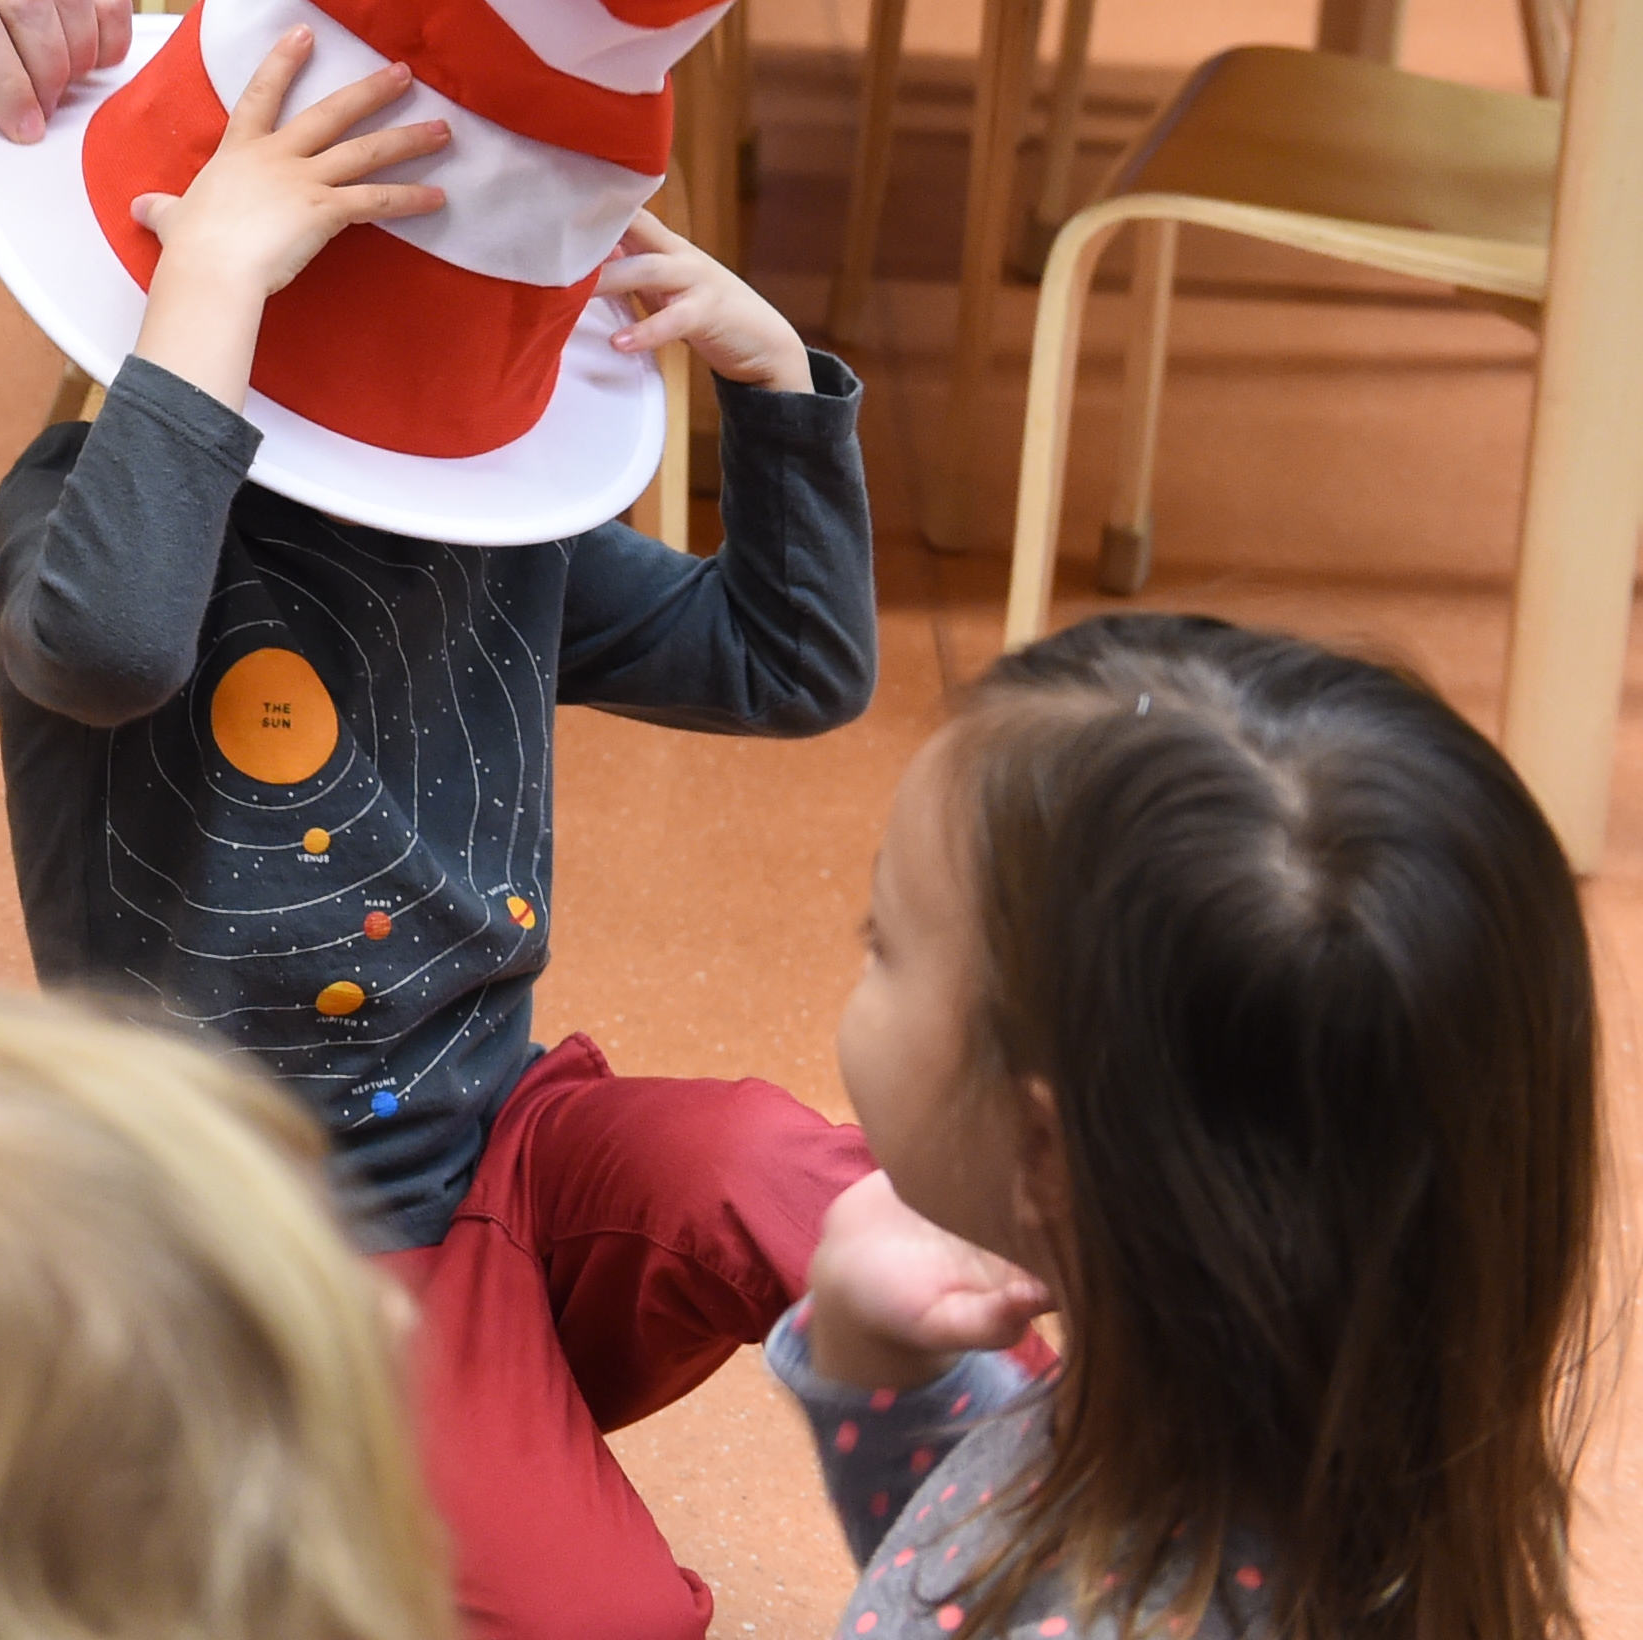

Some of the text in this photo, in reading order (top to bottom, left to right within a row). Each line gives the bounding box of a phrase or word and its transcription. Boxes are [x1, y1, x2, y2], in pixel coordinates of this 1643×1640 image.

[263, 702, 291, 714] THE
[262, 717, 292, 729] SUN
[296, 853, 330, 863] VENUS
[364, 899, 392, 909] MARS
[351, 1076, 398, 1095] NEPTUNE
